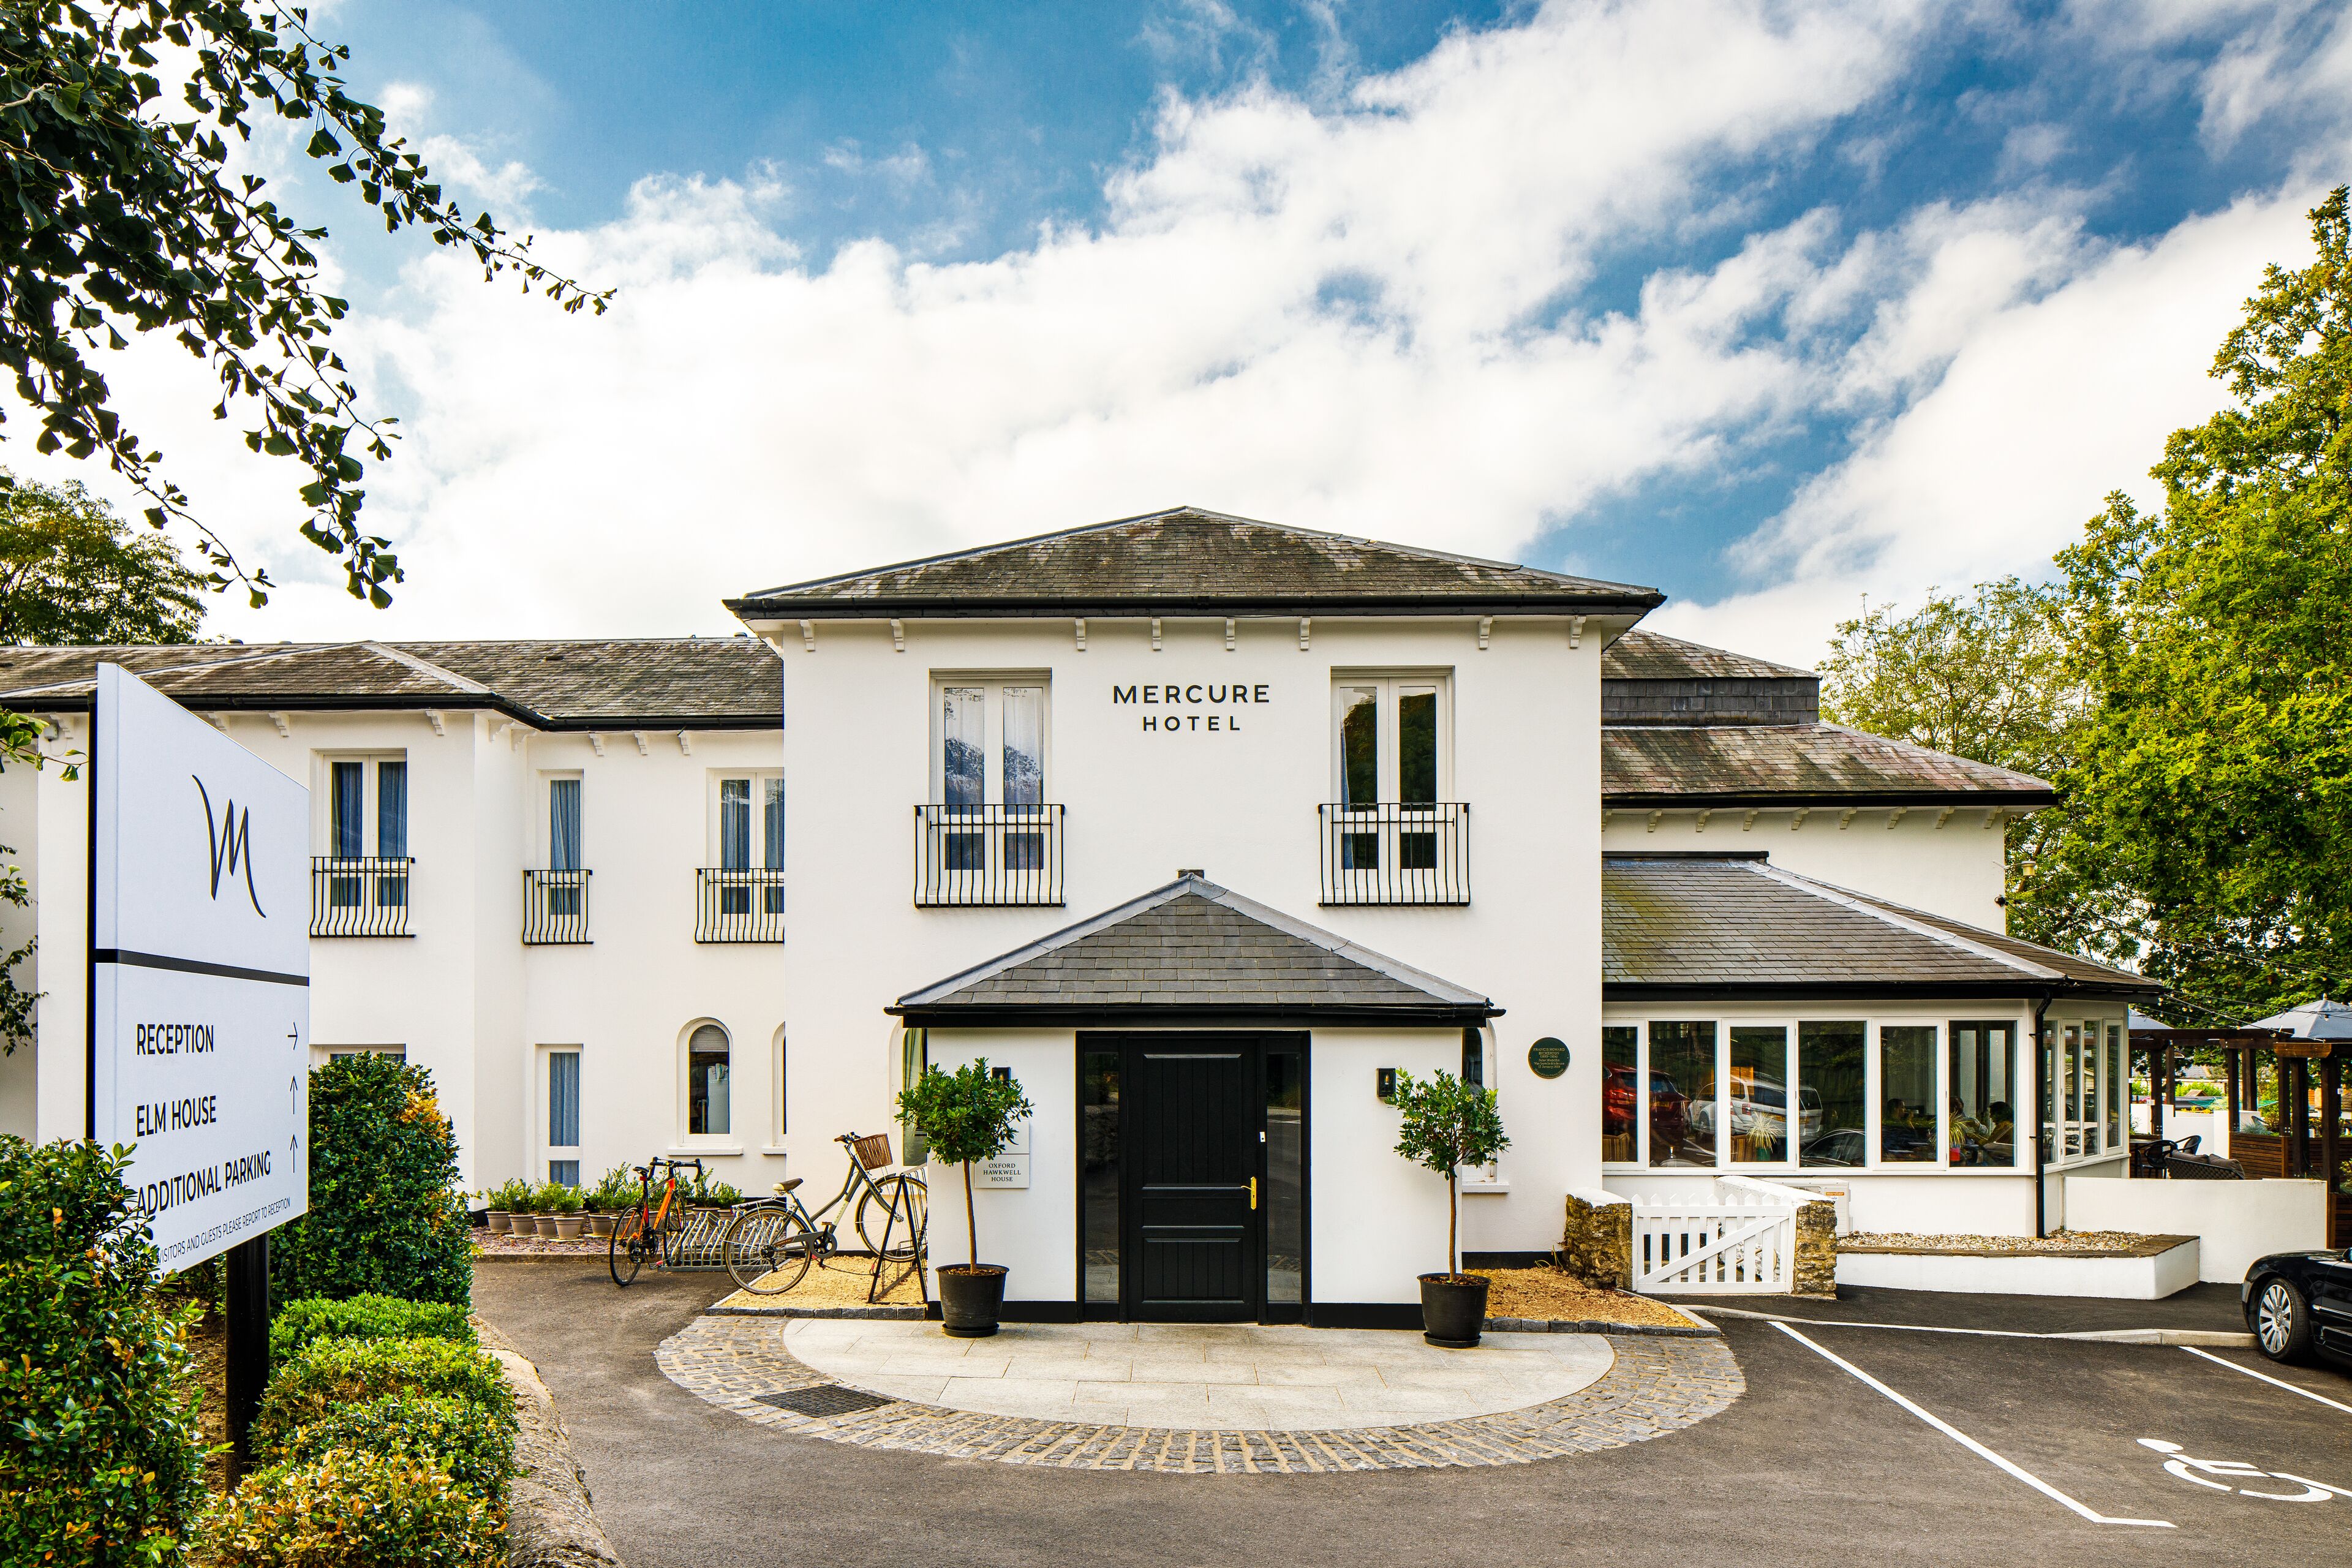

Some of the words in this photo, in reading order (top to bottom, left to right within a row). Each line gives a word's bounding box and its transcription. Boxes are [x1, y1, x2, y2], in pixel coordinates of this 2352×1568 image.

[1113, 684, 1270, 704] MERCURE
[1143, 715, 1240, 731] HOTEL
[137, 1023, 214, 1055] RECEPTION
[137, 1102, 167, 1137] ELM
[172, 1095, 216, 1131] HOUSE
[137, 1165, 222, 1217] ADDITIONAL
[225, 1150, 271, 1189] PARKING
[187, 1235, 200, 1253] AND
[201, 1225, 222, 1246] GUESTS
[223, 1217, 241, 1236] PLEASE
[243, 1208, 260, 1227] REPORT
[261, 1206, 267, 1219] TO
[268, 1196, 290, 1216] RECEPTION
